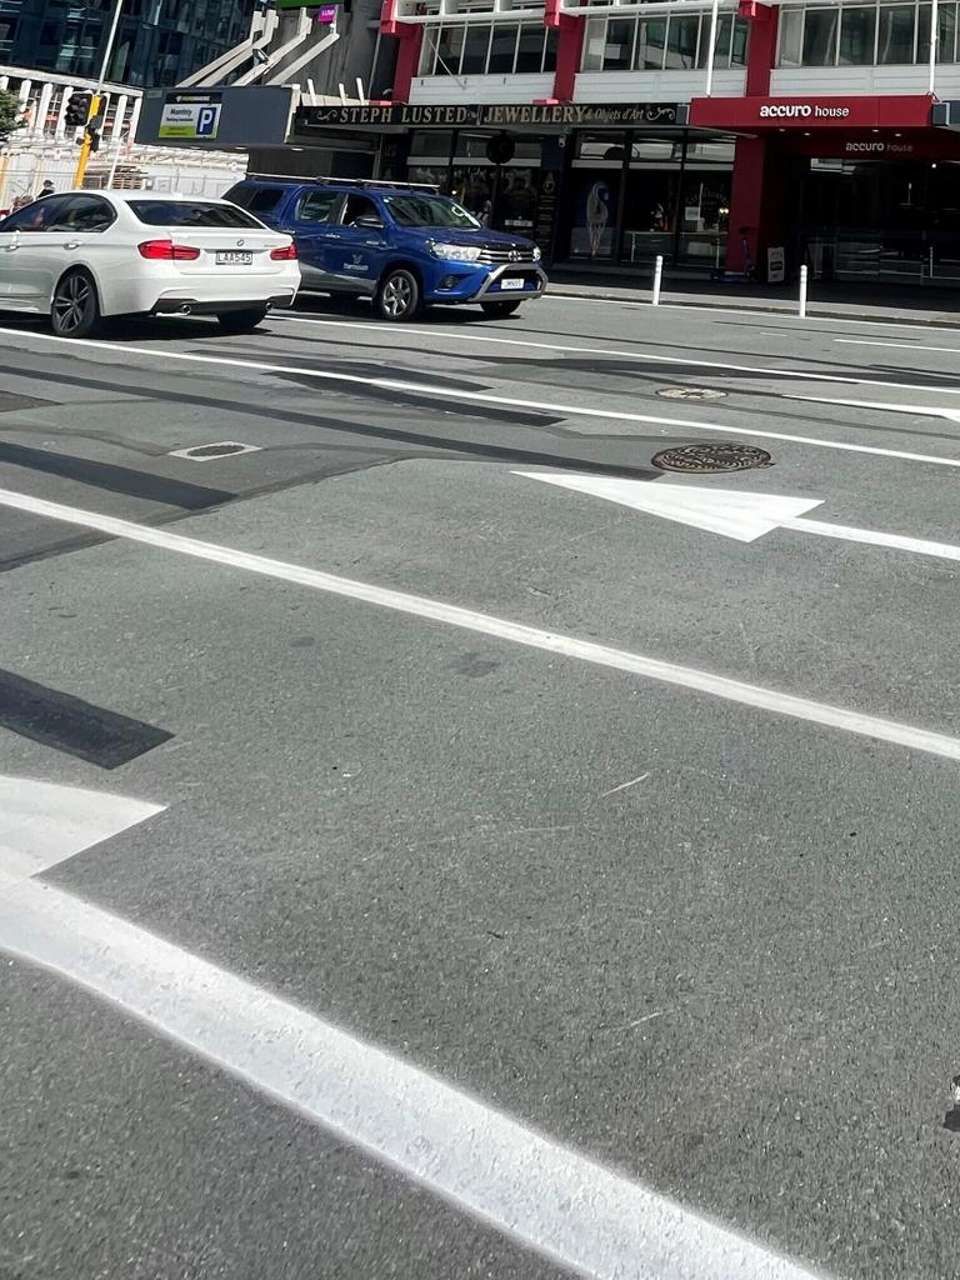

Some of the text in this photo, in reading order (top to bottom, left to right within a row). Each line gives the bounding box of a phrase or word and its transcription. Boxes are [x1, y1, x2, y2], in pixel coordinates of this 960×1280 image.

[340, 107, 467, 123] STEPH LUSTED
[484, 105, 588, 123] JEWELLERY
[760, 105, 849, 117] accuro house
[200, 109, 213, 132] P
[846, 142, 913, 152] accuro house
